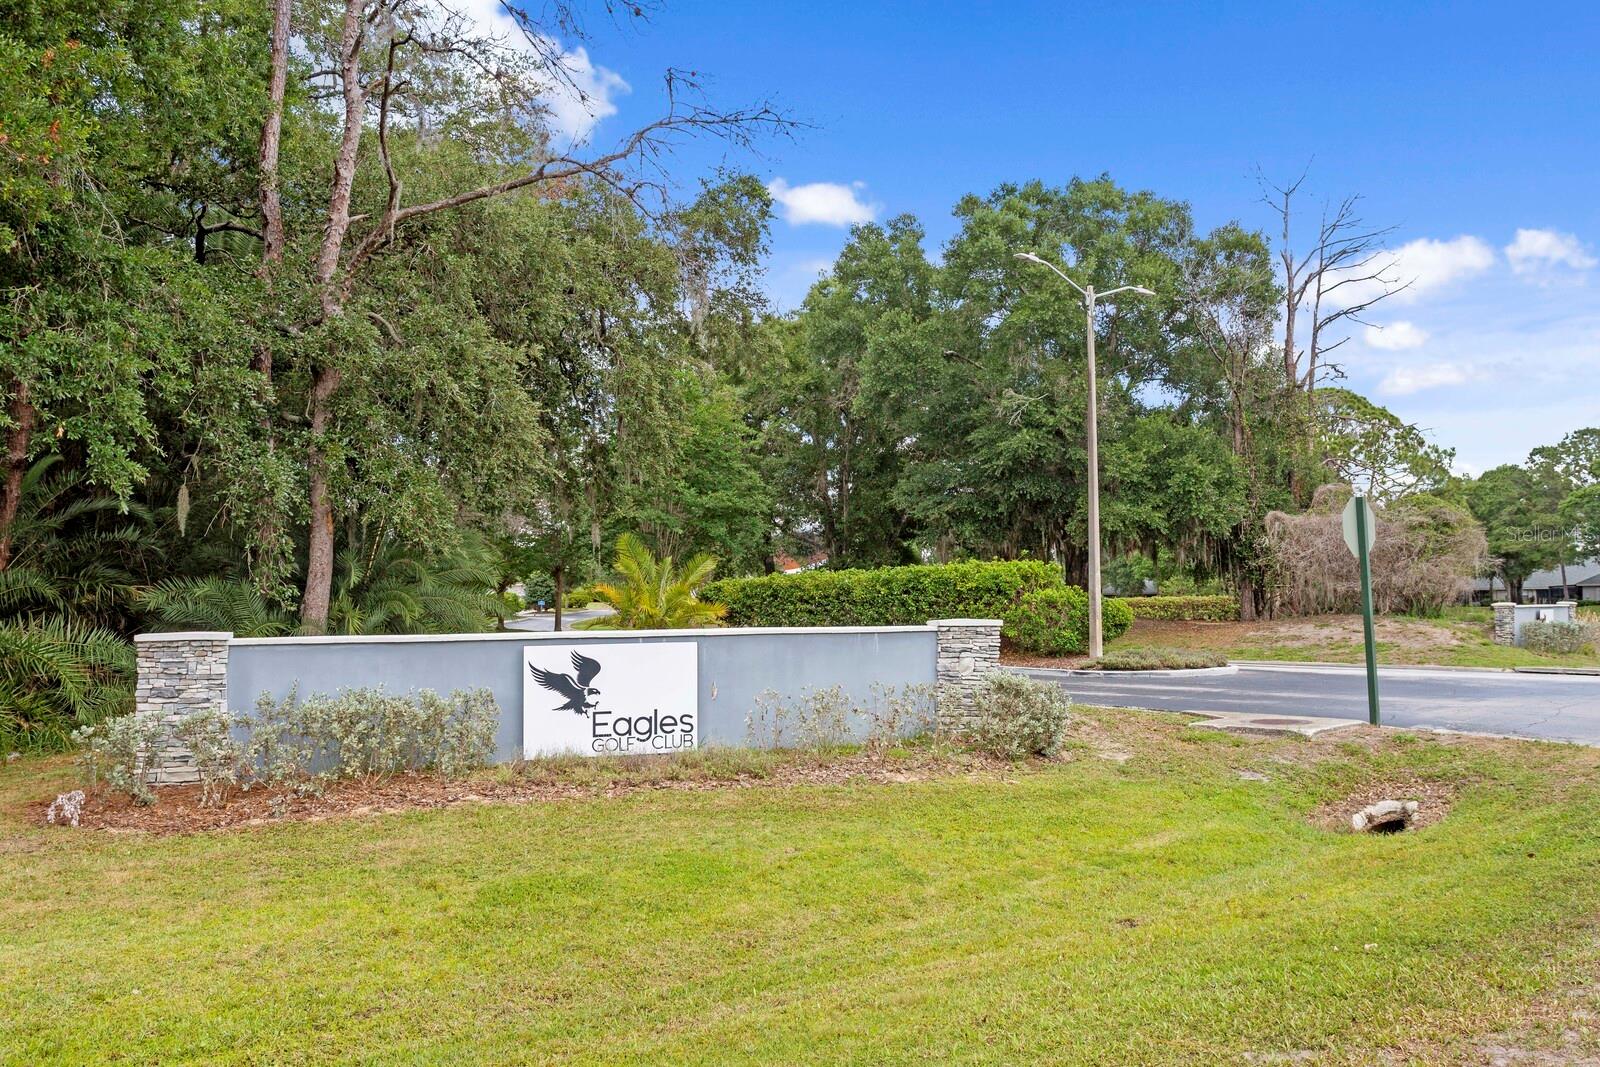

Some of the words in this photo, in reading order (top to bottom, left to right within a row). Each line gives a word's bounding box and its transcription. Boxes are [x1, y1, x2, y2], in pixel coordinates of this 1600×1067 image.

[592, 709, 694, 742] Eagles
[592, 737, 636, 752] GOLF
[652, 734, 694, 749] CLUB
